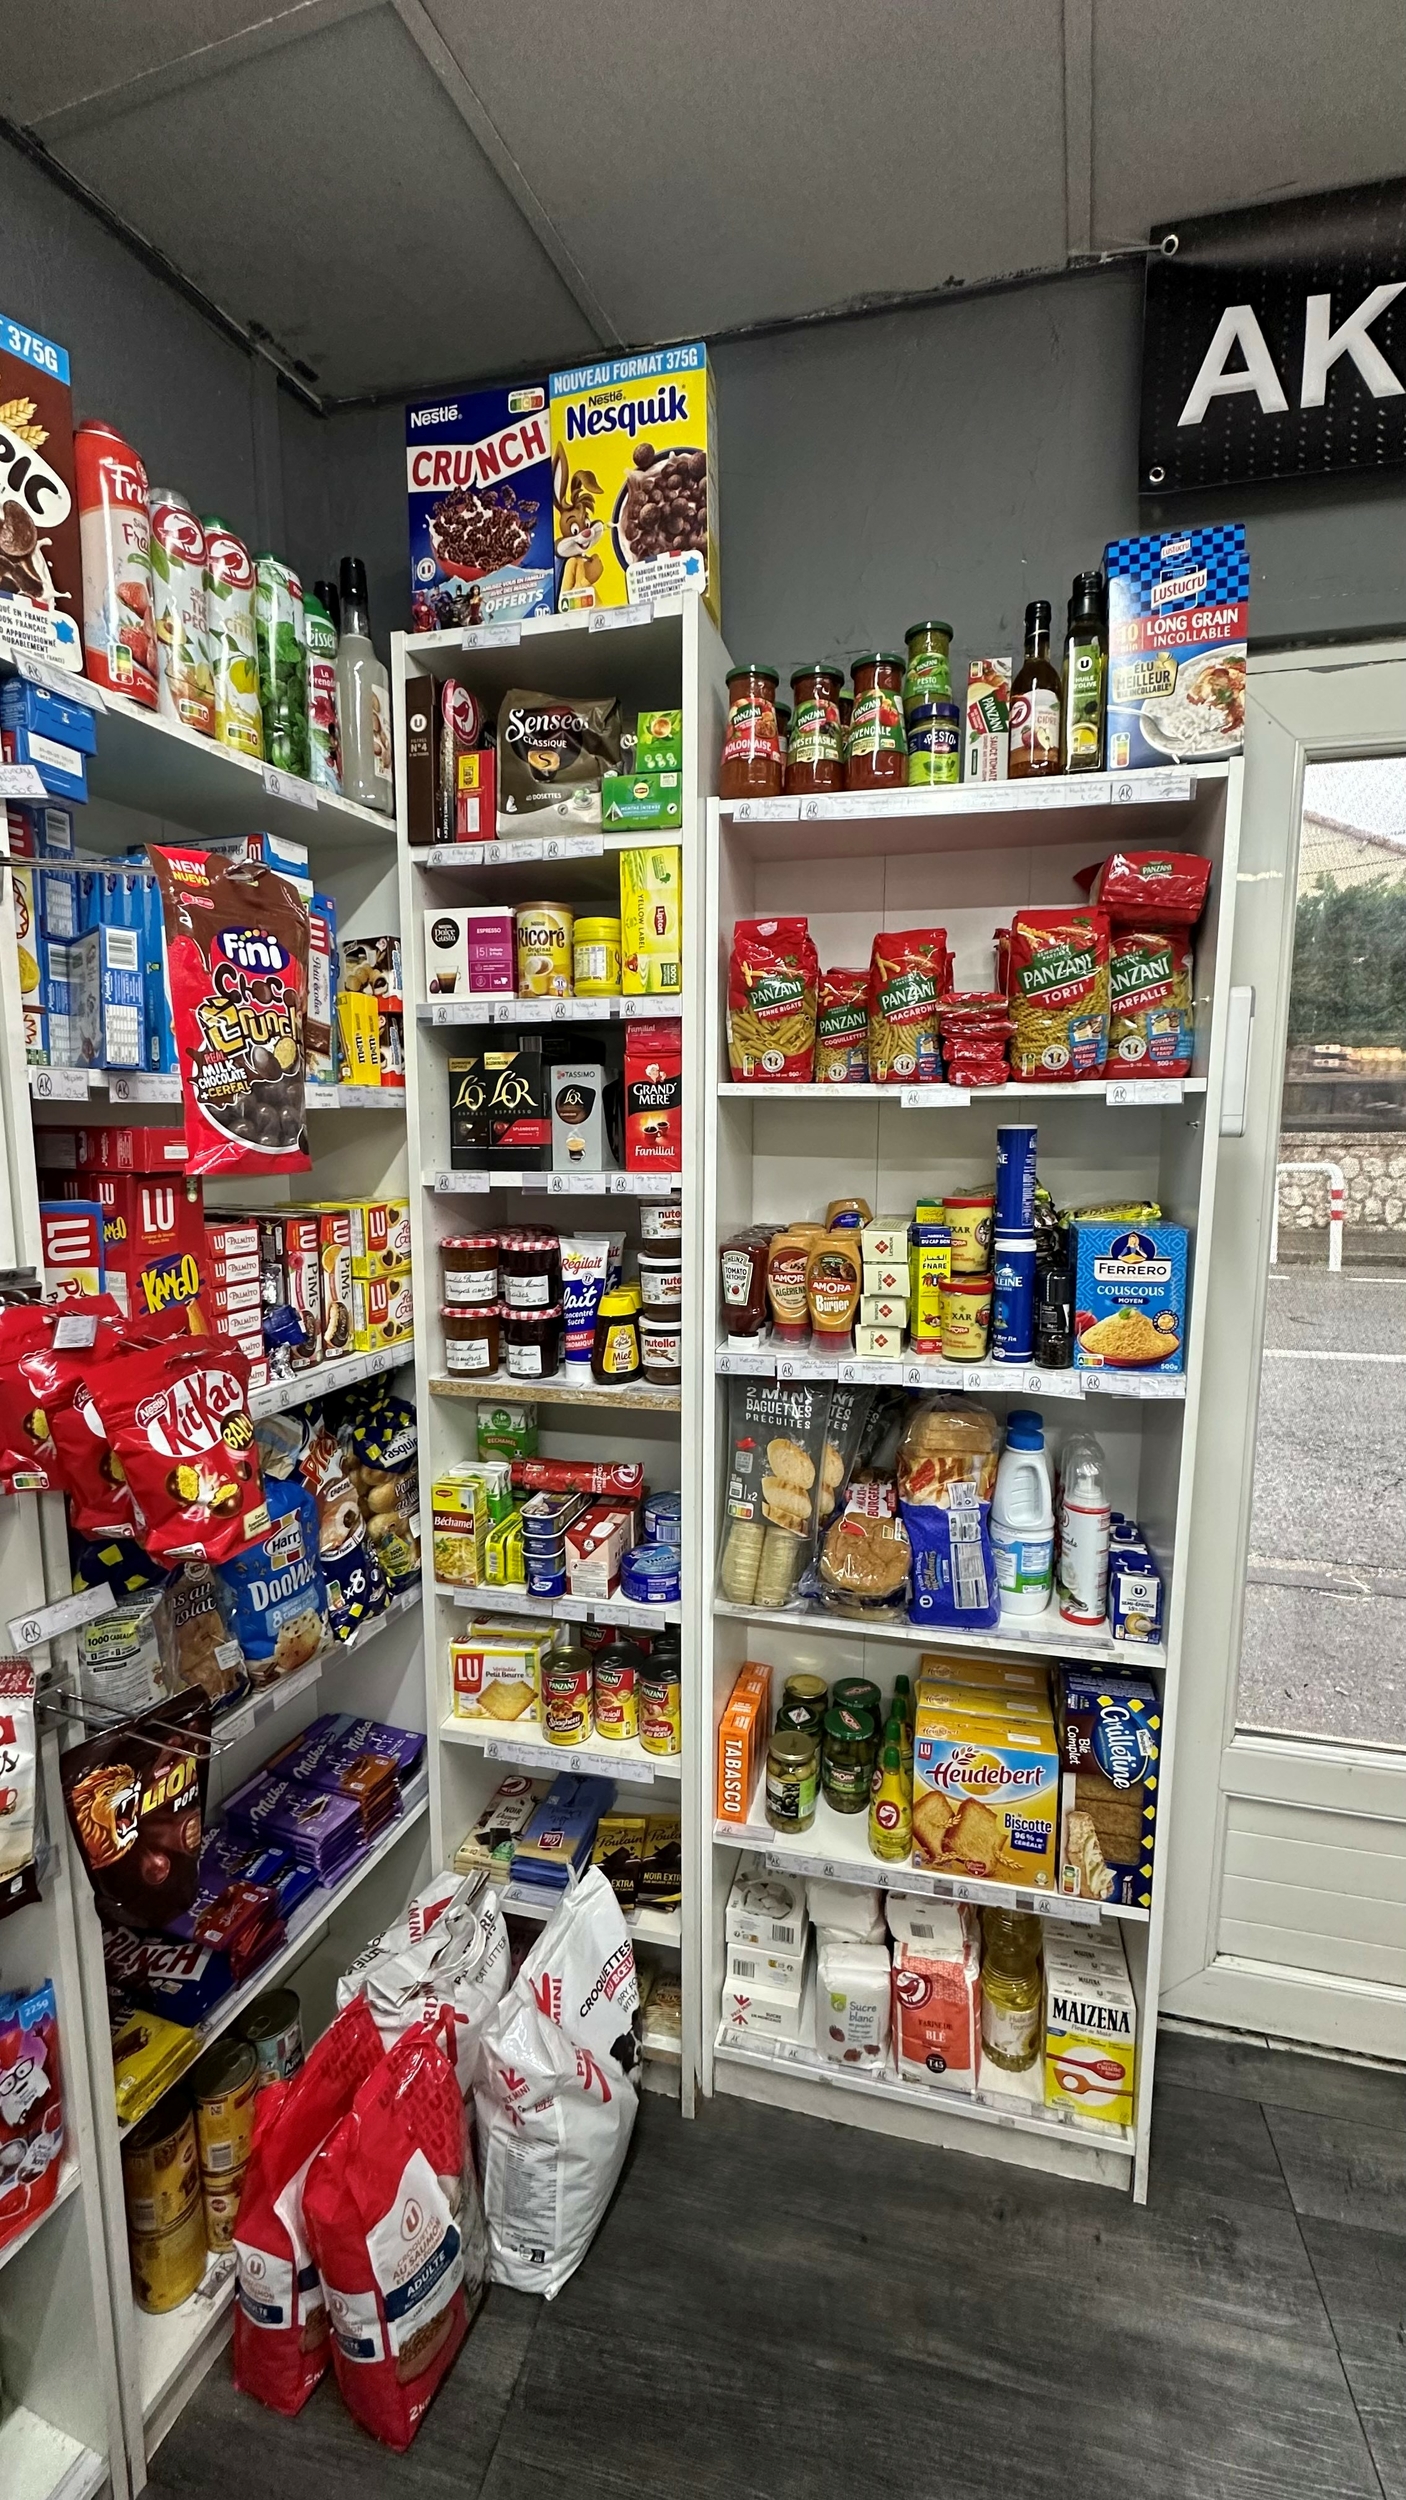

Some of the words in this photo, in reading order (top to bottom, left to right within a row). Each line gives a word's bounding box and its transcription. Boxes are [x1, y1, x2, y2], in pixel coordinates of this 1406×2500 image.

[8, 325, 58, 372] 375G
[554, 366, 610, 394] NOUVEAU
[613, 354, 663, 380] FORMAT
[666, 348, 697, 369] 375G
[589, 390, 623, 407] Nestlé
[411, 405, 458, 428] Nestlé
[566, 385, 688, 440] Nesquik
[413, 420, 547, 486] CRUNCH
[1163, 542, 1190, 556] Lustucru
[1153, 574, 1206, 604] Lustucru
[486, 589, 544, 612] OFFERTS
[24, 611, 48, 624] FRANCE
[1147, 616, 1187, 636] LONG
[1192, 608, 1238, 628] GRAIN
[1154, 626, 1231, 647] INCOLLABLE
[916, 659, 937, 671] PANZANI
[1135, 660, 1154, 673] ÉLU
[917, 677, 936, 685] PESTO
[1116, 670, 1170, 690] MEILLEUR
[734, 708, 761, 724] PANZANI
[798, 709, 825, 725] PANZANI
[854, 698, 881, 717] PANZANI
[982, 697, 1003, 732] PANZANI
[505, 708, 583, 742] Senseo
[411, 743, 427, 752] N°4
[523, 735, 568, 749] CLASSIQUE
[725, 740, 771, 755] BOLOGNAISE
[927, 731, 953, 745] PESTO
[990, 736, 998, 756] SAUCE
[533, 792, 562, 800] DOSETTES
[168, 858, 206, 877] NEW
[1142, 864, 1172, 875] PANZANI
[173, 871, 210, 886] NUEVO
[518, 926, 565, 948] Ricoré
[223, 932, 283, 970] Fini
[312, 956, 322, 979] Petit
[1023, 953, 1092, 989] PANZANI
[751, 979, 802, 1004] PANZANI
[881, 983, 935, 1010] PANZANI
[1042, 984, 1084, 1004] TORTI
[1112, 986, 1168, 1012] FARFALLE
[759, 1008, 779, 1018] PENNE
[780, 1002, 802, 1014] RIGATE
[890, 1004, 935, 1023] MACARONI
[820, 1011, 866, 1033] PANZANI
[824, 1031, 866, 1046] COQUILLETTES
[204, 1052, 226, 1064] REAL
[200, 1067, 247, 1089] CHOCOLATE
[202, 1059, 236, 1078] MILK
[488, 1071, 538, 1108] L'OR
[635, 1145, 675, 1157] Familial
[99, 1183, 115, 1205] LU
[142, 1188, 174, 1232] LU
[369, 1211, 386, 1237] LU
[47, 1219, 91, 1261] LU
[213, 1235, 224, 1249] LU
[299, 1224, 317, 1248] LU
[561, 1256, 602, 1275] Régilait
[727, 1255, 743, 1264] HEINZ
[215, 1263, 225, 1278] LU
[725, 1266, 747, 1276] TOMATO
[726, 1273, 746, 1281] KETCHUP
[1099, 1263, 1167, 1276] FERRERO
[141, 1254, 199, 1314] KANGO
[812, 1282, 851, 1293] AMORA
[1097, 1285, 1165, 1297] COUSCOUS
[216, 1291, 226, 1306] LU
[371, 1282, 386, 1311] LU
[563, 1286, 597, 1310] lait
[815, 1295, 849, 1312] Burger
[217, 1319, 228, 1333] LU
[568, 1318, 585, 1326] Sucré
[645, 1337, 676, 1347] nutella
[613, 1351, 632, 1362] Miel
[747, 1387, 756, 1397] 2
[140, 1397, 166, 1420] Nestlé
[157, 1371, 239, 1456] KitKat
[746, 1398, 812, 1419] BAGUETTES
[746, 1412, 811, 1430] PRÉCUITES
[747, 1492, 758, 1501] x2
[868, 1482, 879, 1517] BURGERS
[434, 1516, 473, 1529] Béchamel
[23, 1622, 40, 1640] AK
[88, 1636, 109, 1647] 1000
[458, 1657, 479, 1681] LU
[550, 1681, 576, 1690] PANZANI
[550, 1716, 581, 1728] Spaghetti
[345, 1720, 373, 1751] Milka
[1067, 1725, 1081, 1765] Complet
[920, 1743, 931, 1755] LU
[1078, 1737, 1091, 1754] Blé
[1100, 1706, 1136, 1789] Grilletine
[293, 1744, 327, 1779] Milka
[724, 1739, 742, 1813] TABASCO
[926, 1762, 1044, 1788] Heudebert
[250, 1781, 289, 1825] Milka
[504, 1806, 522, 1815] NOIR
[1004, 1813, 1052, 1833] Biscotte
[597, 1833, 644, 1848] Poulain
[612, 1879, 634, 1888] EXTRA
[644, 1872, 662, 1881] NOIR
[475, 1970, 487, 1984] CAT
[486, 1936, 507, 1968] LITTER
[579, 1940, 631, 2018] CROQUETTES
[605, 1984, 614, 1997] AU
[24, 2000, 48, 2017] 225g
[552, 1978, 562, 2029] MINI
[850, 2001, 877, 2013] Sucre
[850, 2012, 874, 2023] blanc
[1053, 1997, 1130, 2034] MAIZENA
[926, 2030, 946, 2043] BLÉ
[1071, 2024, 1087, 2032] Fleur
[929, 2059, 944, 2069] T45
[409, 2217, 441, 2263] SAUMON
[408, 2250, 446, 2297] ADULTE
